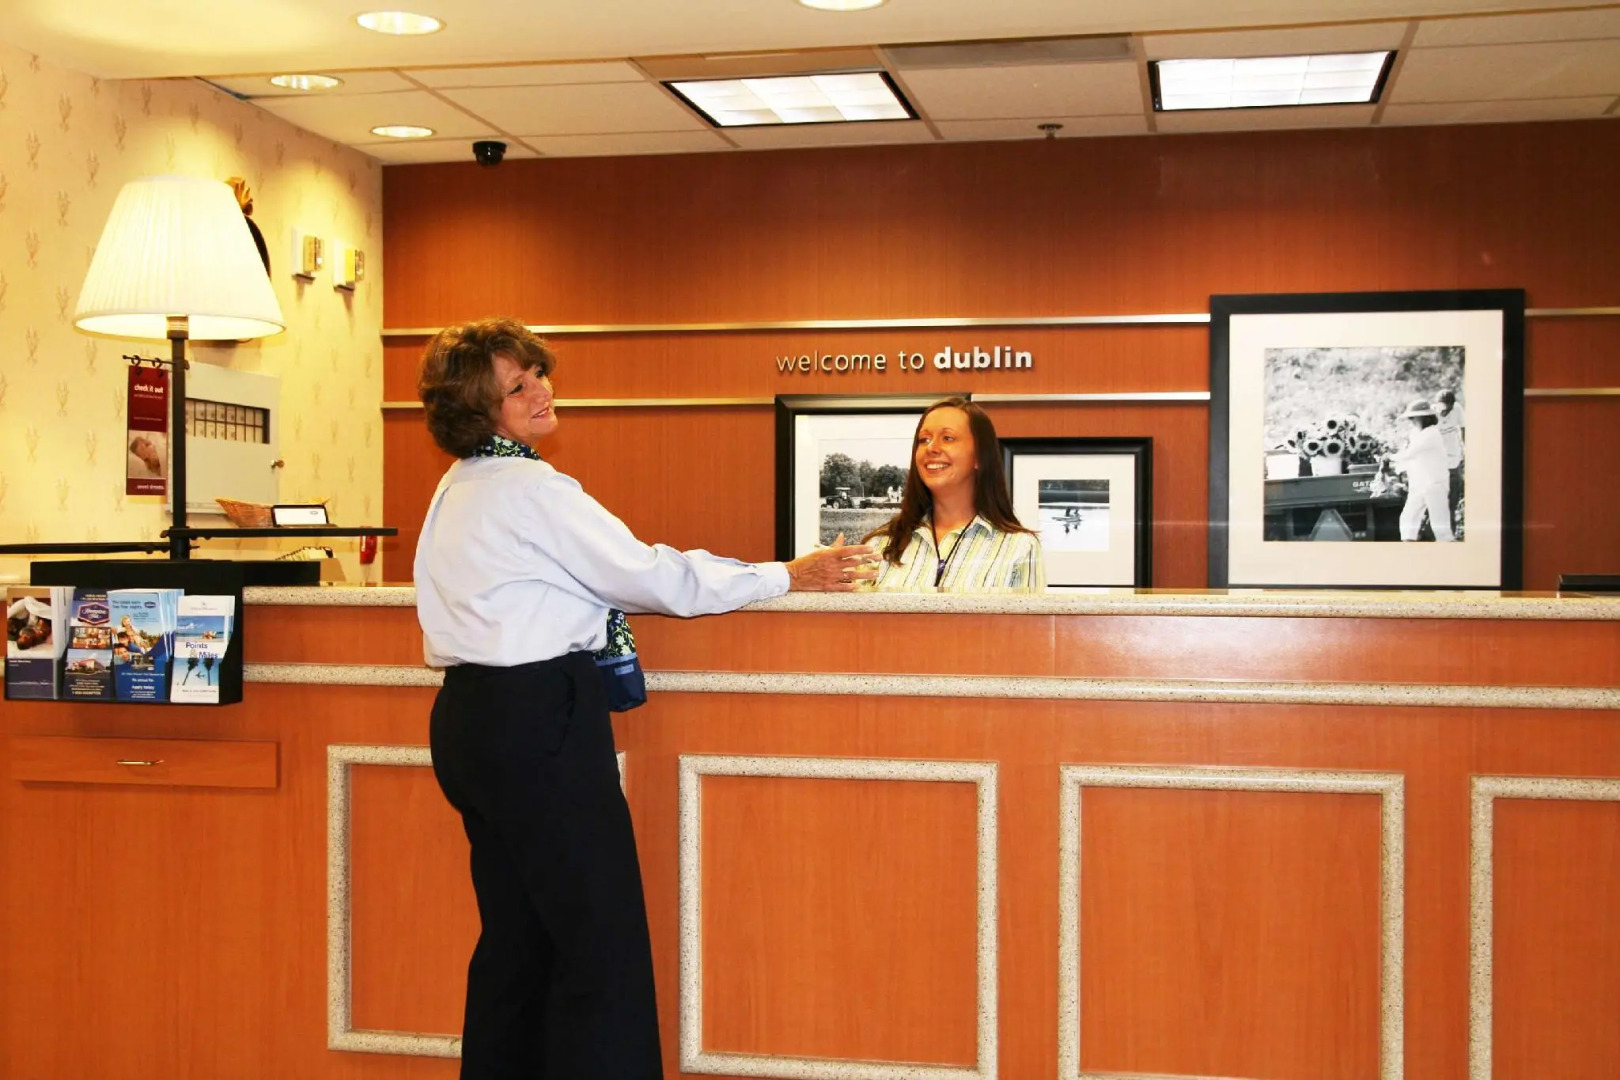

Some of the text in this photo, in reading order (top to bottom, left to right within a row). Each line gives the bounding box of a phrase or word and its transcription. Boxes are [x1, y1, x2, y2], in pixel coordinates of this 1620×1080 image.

[776, 346, 1033, 372] welcome to dublin
[134, 384, 148, 392] check
[198, 651, 219, 659] Miles
